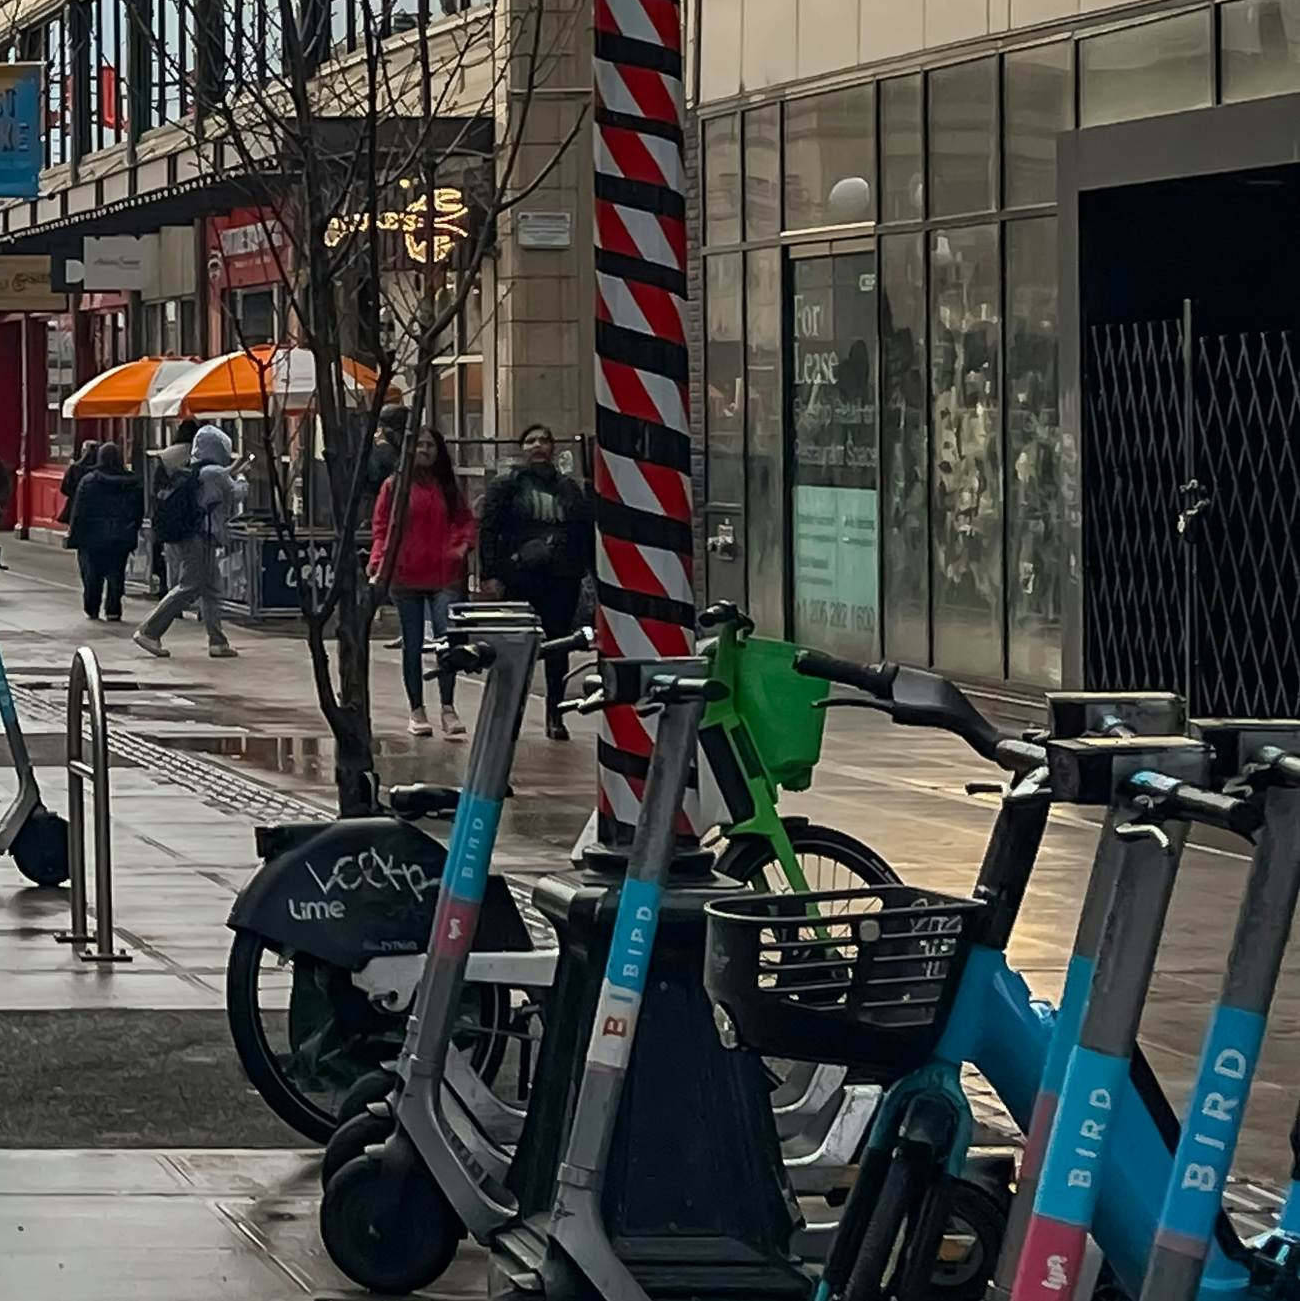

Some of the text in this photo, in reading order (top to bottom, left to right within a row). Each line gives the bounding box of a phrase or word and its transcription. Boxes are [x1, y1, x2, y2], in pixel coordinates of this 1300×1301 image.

[794, 342, 839, 384] Lease
[461, 817, 484, 879] BIRD
[622, 906, 653, 978] BIRD
[1067, 1088, 1112, 1189] BIRD
[1181, 1048, 1247, 1192] BIRD
